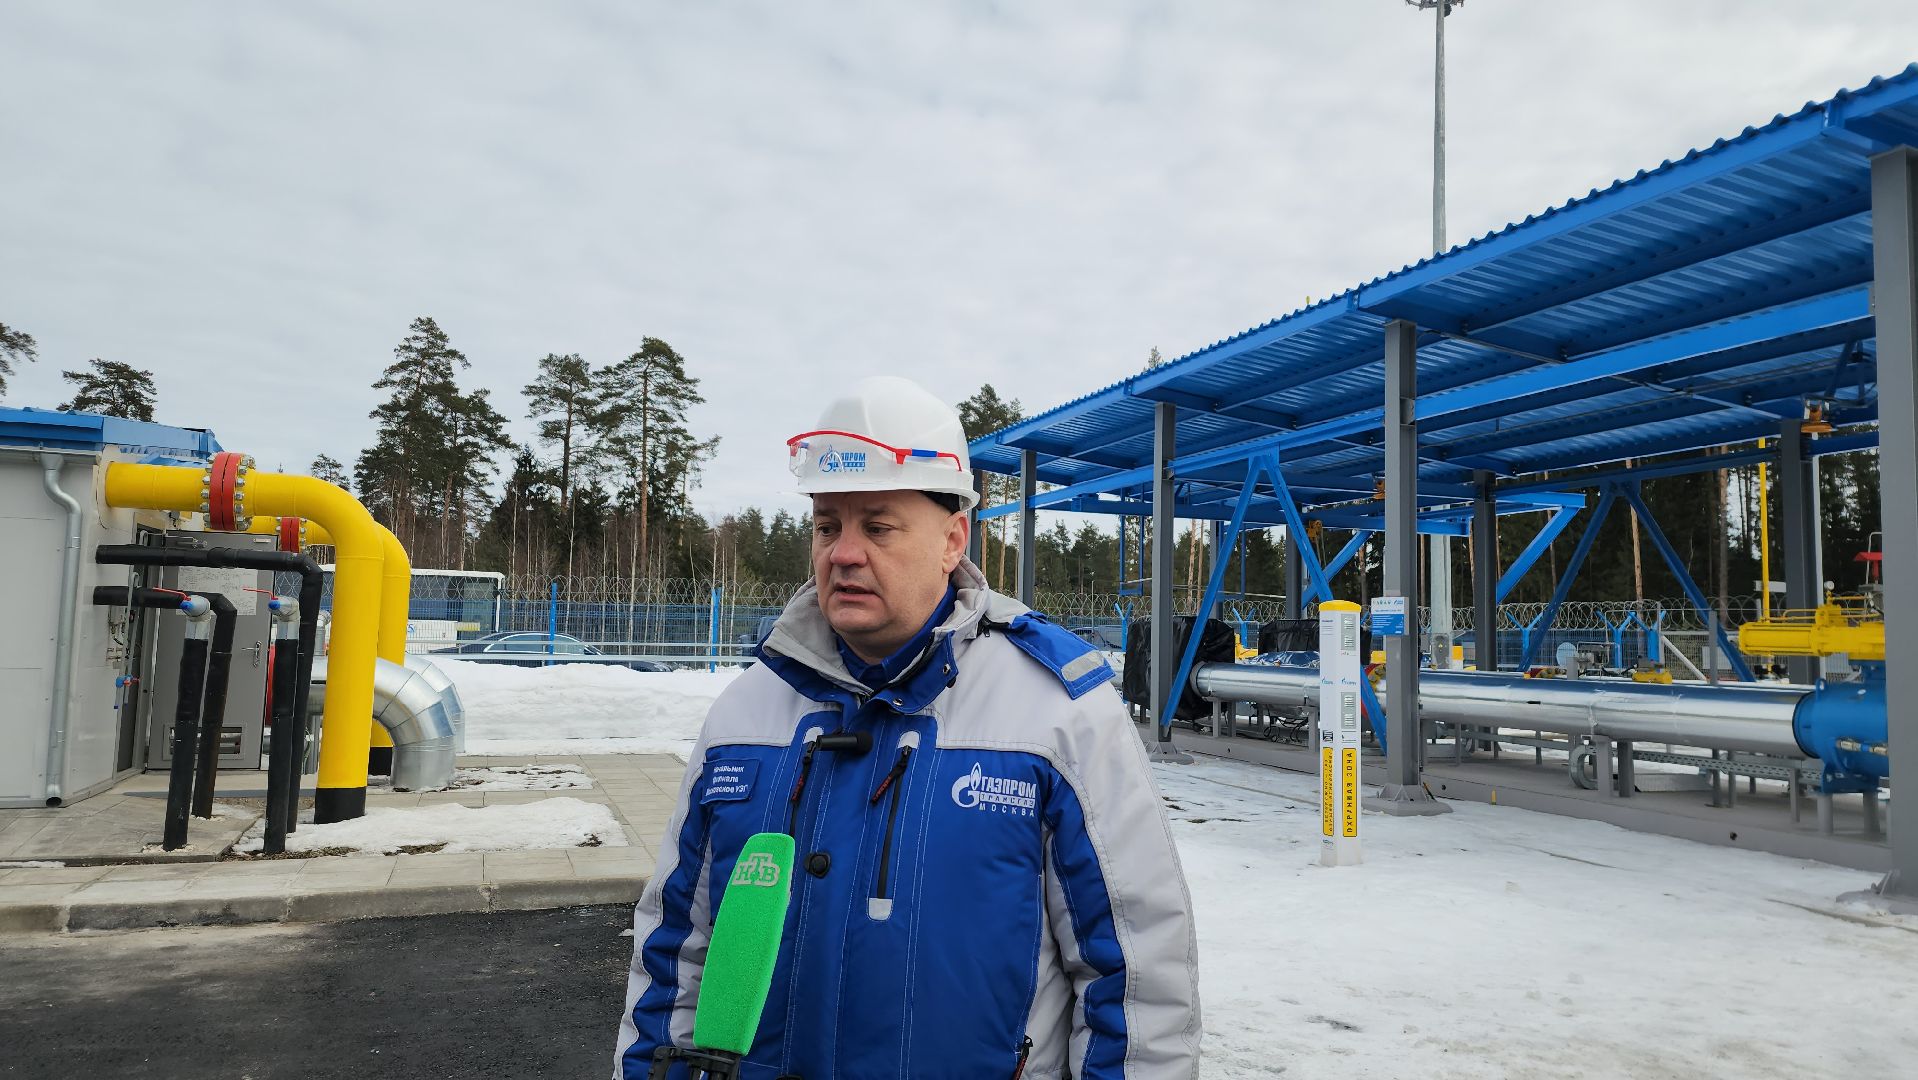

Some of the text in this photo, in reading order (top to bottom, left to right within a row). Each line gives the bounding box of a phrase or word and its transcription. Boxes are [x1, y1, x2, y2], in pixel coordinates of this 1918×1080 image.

[981, 776, 1037, 798] ГАЗПРОМ
[981, 793, 1034, 807] ТРАНСГАЗ
[979, 803, 1035, 817] МОСКВА
[734, 854, 778, 885] НТВ
